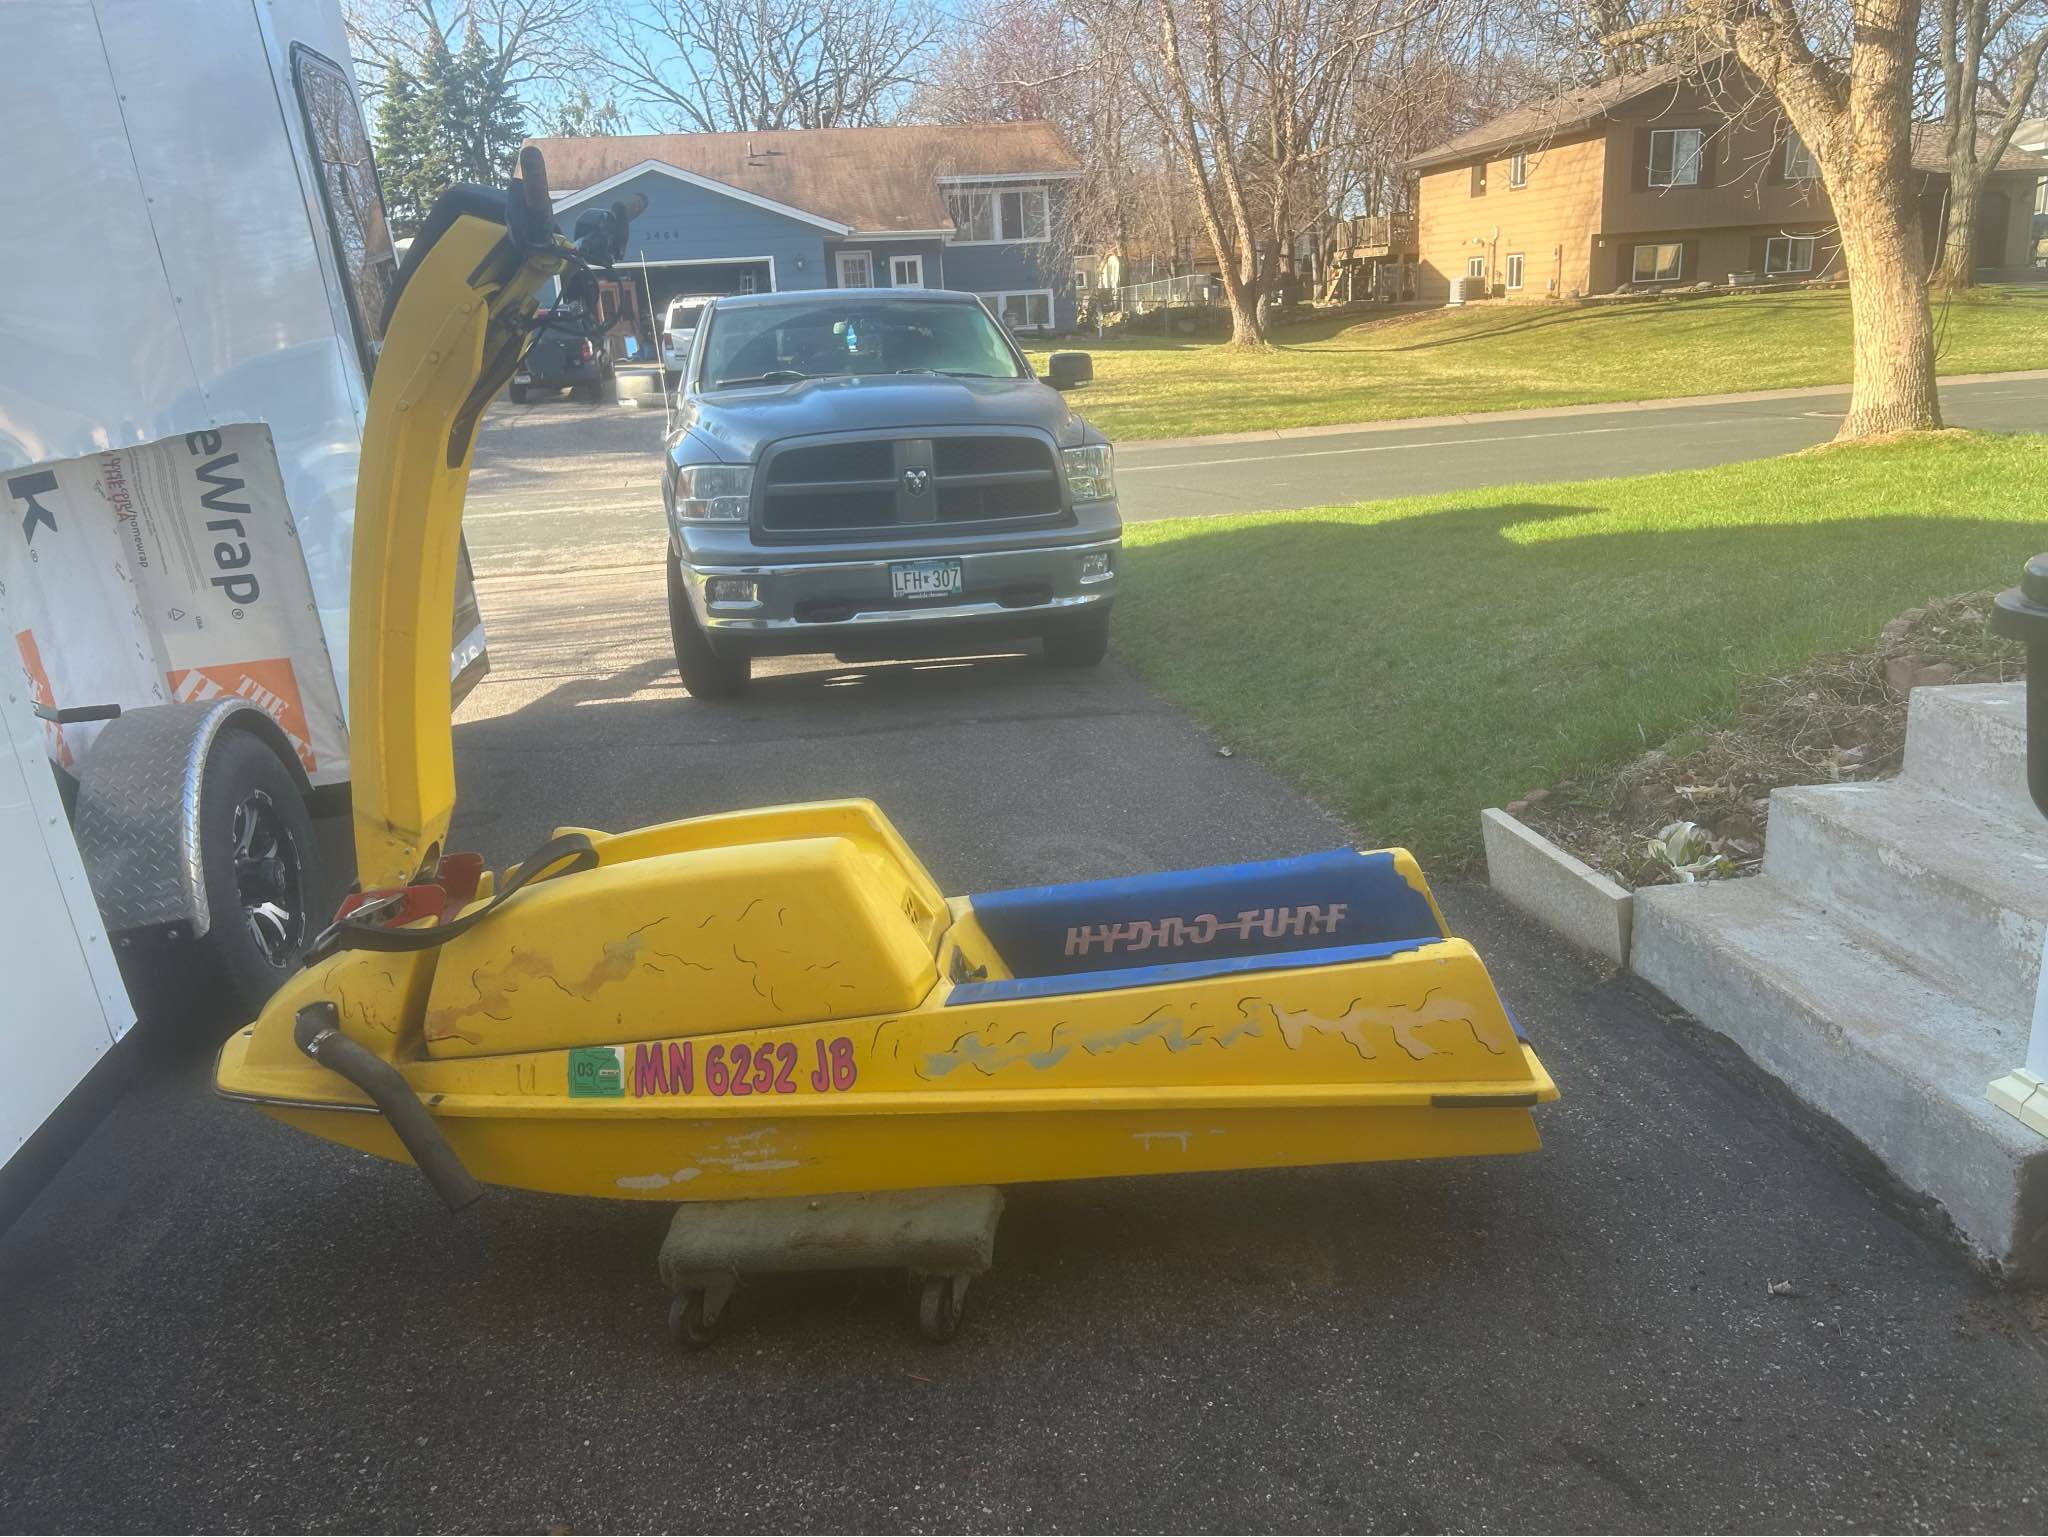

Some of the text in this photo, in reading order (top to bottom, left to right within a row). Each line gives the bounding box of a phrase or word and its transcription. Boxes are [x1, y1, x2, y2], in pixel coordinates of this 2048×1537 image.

[894, 569, 959, 592] LFH 307
[236, 674, 289, 719] THE
[577, 1061, 594, 1078] 03
[634, 1036, 858, 1098] MN 6252 JB
